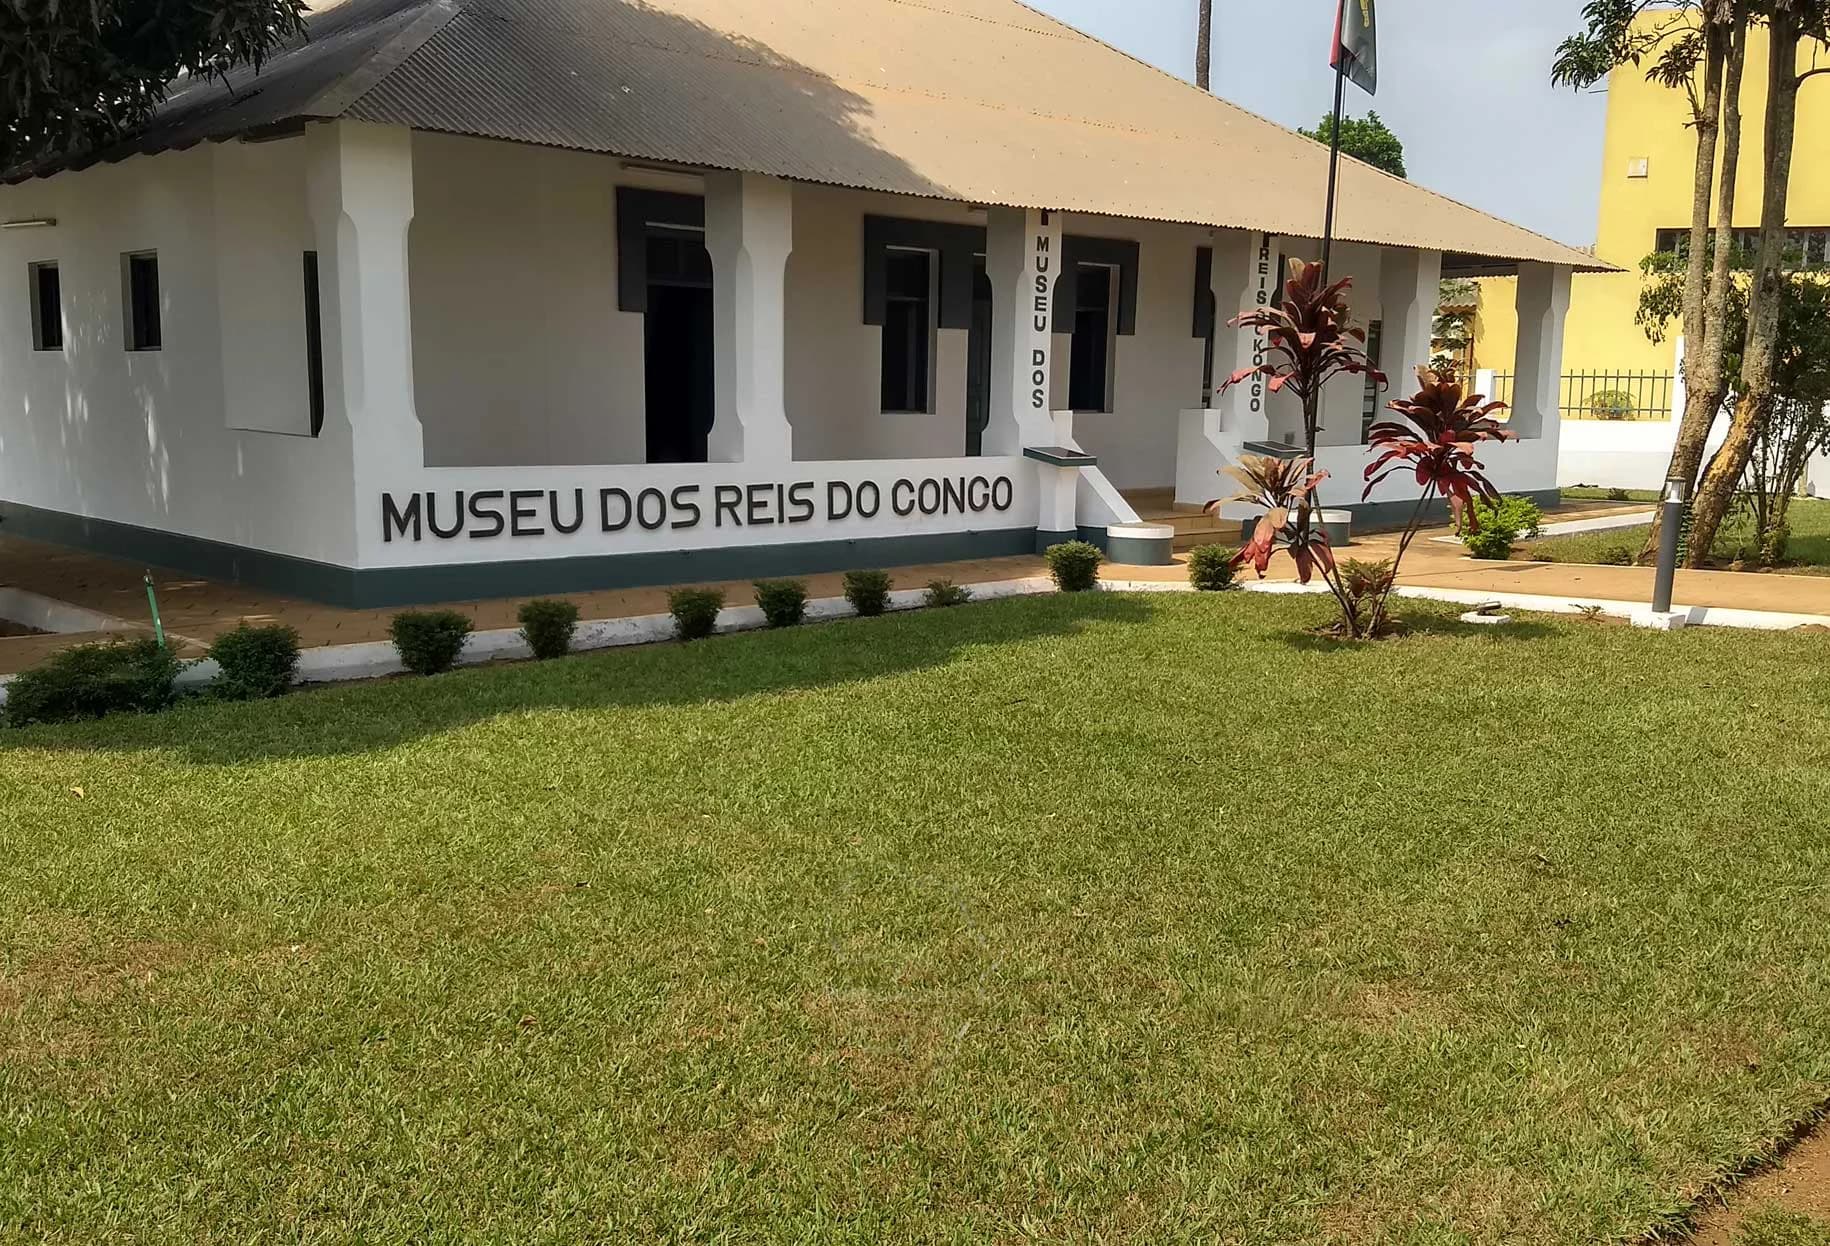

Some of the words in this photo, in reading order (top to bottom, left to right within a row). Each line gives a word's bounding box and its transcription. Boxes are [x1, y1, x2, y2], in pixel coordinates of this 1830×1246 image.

[1033, 235, 1050, 332] MUSEU
[1256, 247, 1270, 305] REIS
[1032, 349, 1045, 409] DOS
[1250, 338, 1264, 412] KONGO
[381, 489, 583, 543] MUSEU
[599, 484, 701, 533] DOS
[714, 480, 815, 528] REIS
[826, 480, 881, 521] DO
[891, 475, 1013, 517] CONGO
